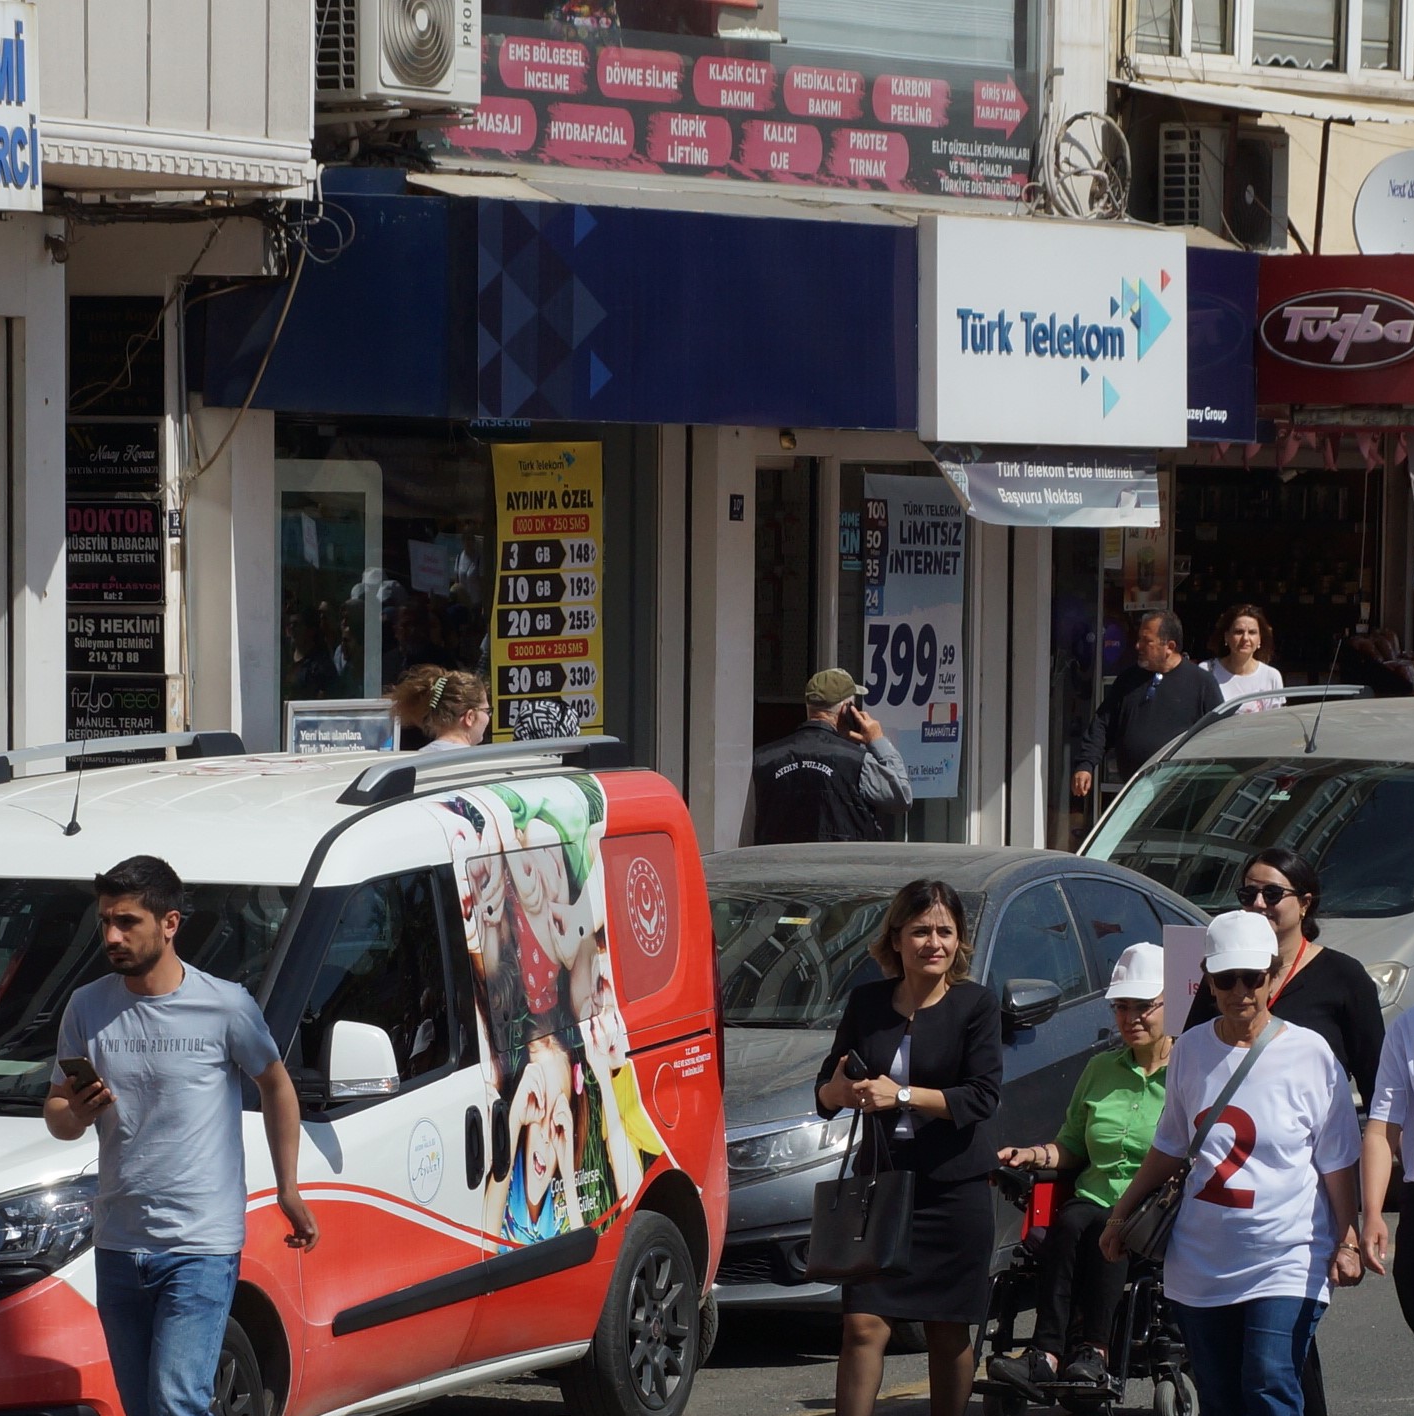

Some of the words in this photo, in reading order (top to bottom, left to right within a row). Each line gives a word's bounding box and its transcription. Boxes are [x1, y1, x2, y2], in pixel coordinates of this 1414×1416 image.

[508, 44, 530, 60] EMS
[533, 42, 585, 66] BÖLGESEL
[524, 67, 569, 90] İNCELME
[606, 62, 643, 85] DÖVME
[645, 65, 678, 89] SİLME
[709, 63, 744, 82] KLASİK
[745, 66, 766, 85] CİLT
[793, 71, 835, 93] MEDİKAL
[837, 75, 857, 94] CİLT
[891, 79, 931, 98] KARBON
[981, 84, 1000, 102] GİRİŞ
[1002, 89, 1016, 102] YAN
[721, 90, 754, 107] BAKIMI
[808, 98, 842, 117] BAKIMI
[891, 103, 932, 124] PEELİNG
[976, 106, 1020, 122] TARAFTADIR
[477, 115, 521, 134] MASAJI
[551, 121, 626, 145] HYDRAFACİAL
[670, 113, 706, 138] KİRPİK
[764, 124, 796, 143] KALICI
[850, 132, 887, 150] PROTEZ
[932, 138, 947, 154] ELİT
[949, 139, 982, 157] GÜZELLİK
[983, 143, 1030, 161] EKİPMANLARI
[668, 145, 708, 165] LİFTİNG
[770, 152, 789, 169] OJE
[849, 158, 886, 177] TIRNAK
[949, 160, 958, 173] VE
[979, 161, 1012, 178] CİHAZLAR
[940, 176, 969, 193] TÜRKİYE
[957, 308, 1013, 353] Türk
[1020, 311, 1125, 361] Telekom
[1205, 408, 1227, 423] Group
[518, 459, 535, 471] Türk
[537, 457, 564, 471] Telekom
[996, 461, 1020, 478] Türk
[1023, 461, 1065, 478] Telekom
[1067, 461, 1092, 479] Evde
[1095, 459, 1133, 480] İnternet
[507, 490, 558, 511] AYDIN'A
[561, 483, 594, 509] ÖZEL
[998, 487, 1042, 507] Başvuru
[1044, 488, 1083, 505] Noktası
[867, 501, 885, 519] 100
[903, 501, 923, 516] TÜRK
[926, 503, 961, 517] TELEKOM
[69, 508, 154, 533] DOKTOR
[553, 517, 569, 531] 250
[570, 517, 586, 530] SMS
[66, 533, 109, 550] HÜSEYİN
[112, 536, 159, 550] BABACAN
[866, 530, 881, 548] 50
[899, 520, 961, 546] LİMİTSİZ
[69, 552, 113, 563] MEDİKAL
[117, 553, 156, 563] ESTETİK
[509, 543, 519, 569] 3
[535, 546, 551, 563] GB
[889, 549, 961, 576] İNTERNET
[866, 559, 879, 577] 35
[103, 581, 160, 590] EPİLASYON
[508, 576, 529, 602] 10
[536, 580, 551, 597] GB
[866, 590, 879, 607] 24
[68, 615, 95, 636] DİŞ
[101, 616, 160, 634] HEKİMİ
[507, 610, 531, 636] 20
[535, 614, 552, 630] GB
[75, 636, 114, 650] Süleyman
[117, 636, 154, 649] DEMİRCİ
[514, 645, 534, 657] 3000
[535, 645, 546, 656] DK
[553, 644, 567, 655] 250
[568, 642, 584, 654] SMS
[89, 652, 107, 663] 214
[864, 623, 937, 706] 399
[508, 667, 531, 693] 30
[536, 671, 552, 687] GB
[939, 673, 955, 684] TL/AY
[76, 717, 116, 728] MANUEL
[120, 716, 153, 728] TERAPİ
[300, 730, 316, 740] Yeni
[319, 730, 330, 741] hat
[775, 762, 799, 779] AYDIN
[802, 760, 834, 777] PULLUK
[100, 1039, 120, 1053] FIND
[125, 1038, 147, 1053] YOUR
[151, 1037, 205, 1053] ADVENTURE
[1194, 1105, 1257, 1209] 2
